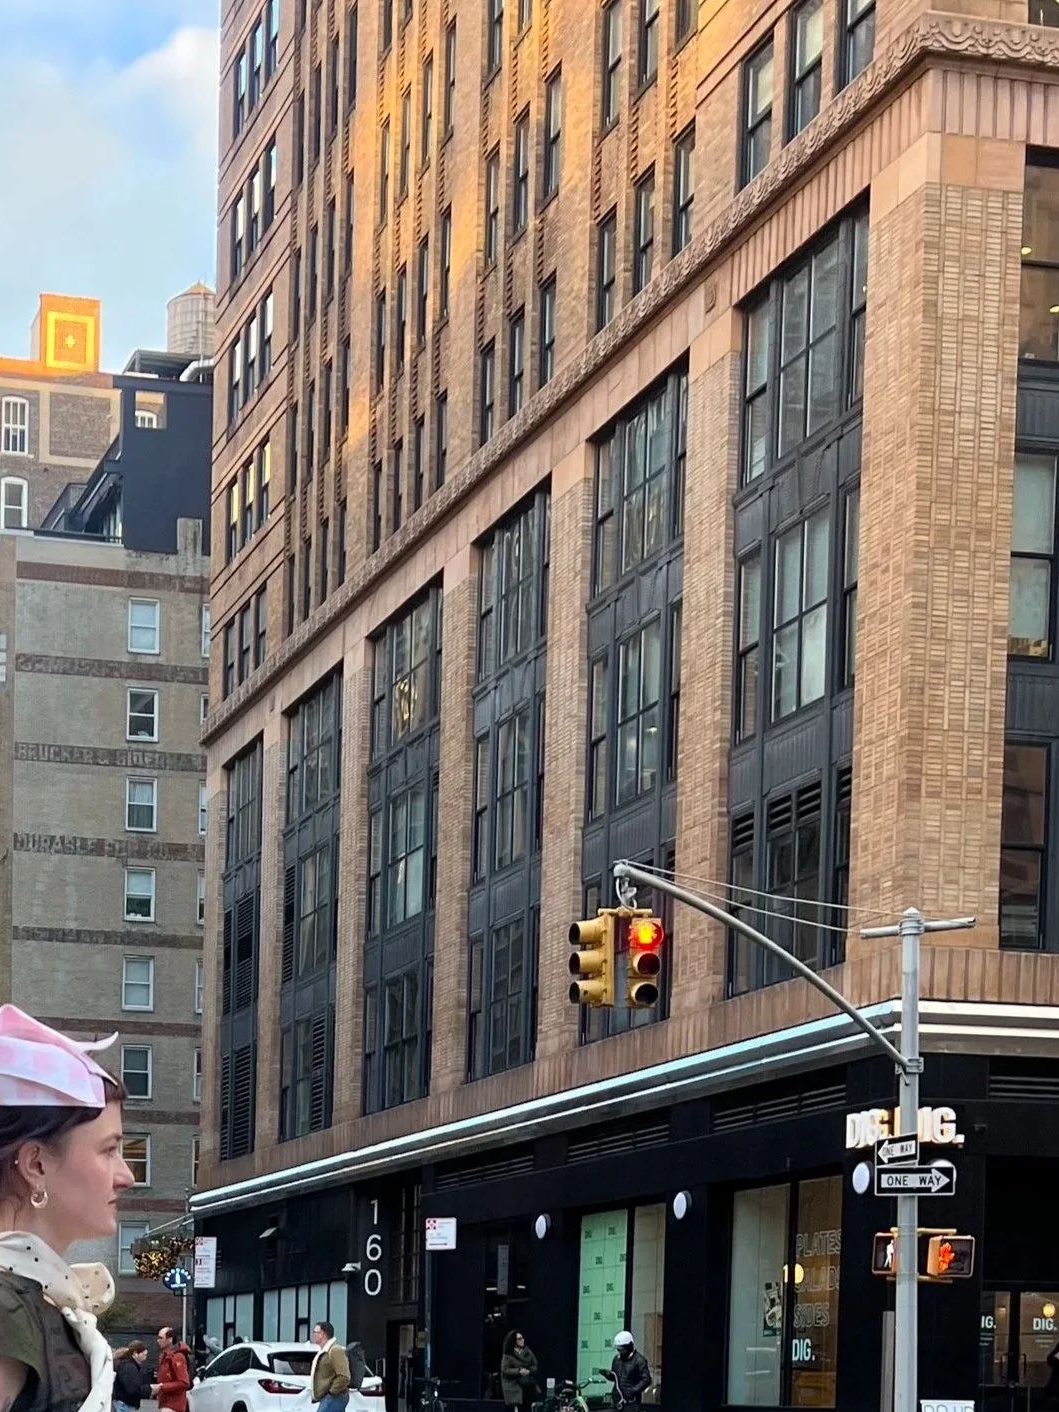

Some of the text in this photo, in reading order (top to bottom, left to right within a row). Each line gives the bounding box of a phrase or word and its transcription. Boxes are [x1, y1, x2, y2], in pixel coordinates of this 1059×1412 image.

[882, 1143, 913, 1157] ONE WAY
[886, 1175, 942, 1186] ONE WAY
[364, 1199, 382, 1296] 160
[795, 1229, 842, 1258] PLATES
[793, 1302, 830, 1328] SIDES
[1033, 1317, 1058, 1331] DIG.
[792, 1338, 816, 1361] DIG.
